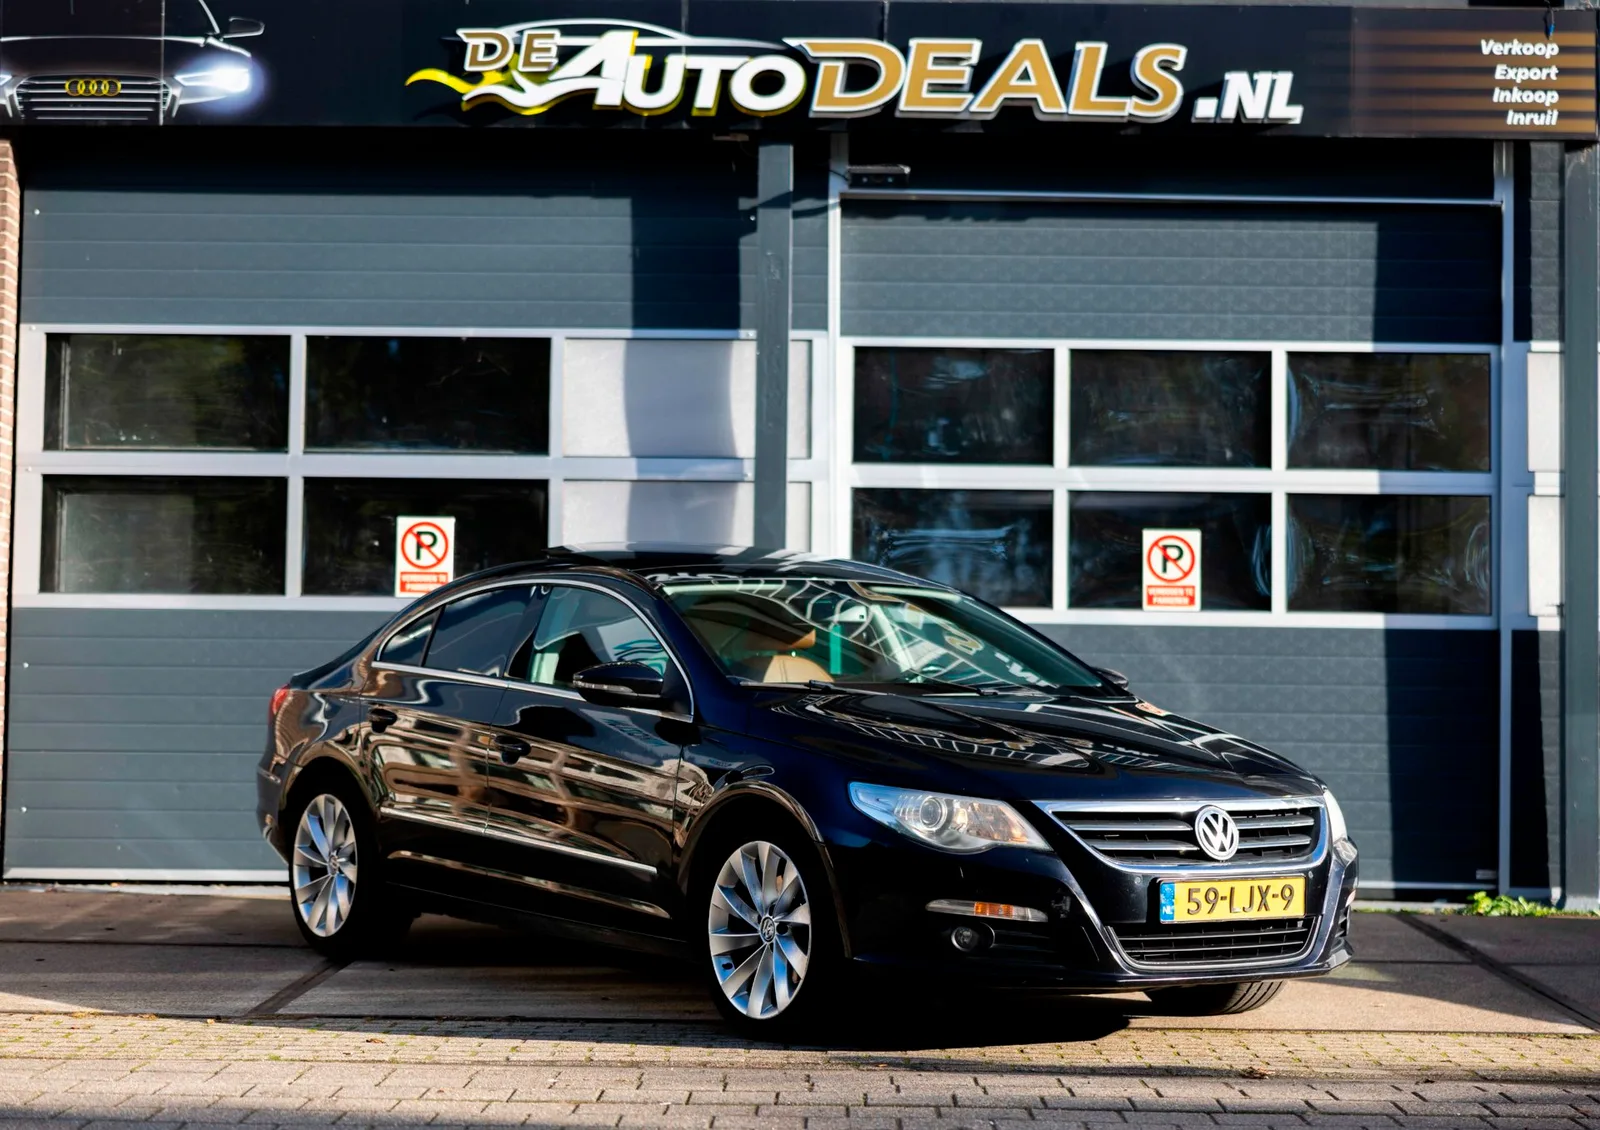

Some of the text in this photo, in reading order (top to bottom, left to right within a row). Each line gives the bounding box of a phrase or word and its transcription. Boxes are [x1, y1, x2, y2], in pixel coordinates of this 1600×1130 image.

[456, 28, 561, 72] DE
[1481, 39, 1559, 59] Verkoop
[1494, 64, 1559, 83] Export
[1492, 86, 1559, 107] Inkoop
[1506, 109, 1559, 125] Inruil
[416, 531, 438, 560] P
[1162, 545, 1184, 574] P
[1187, 883, 1295, 916] 59-LJX-9
